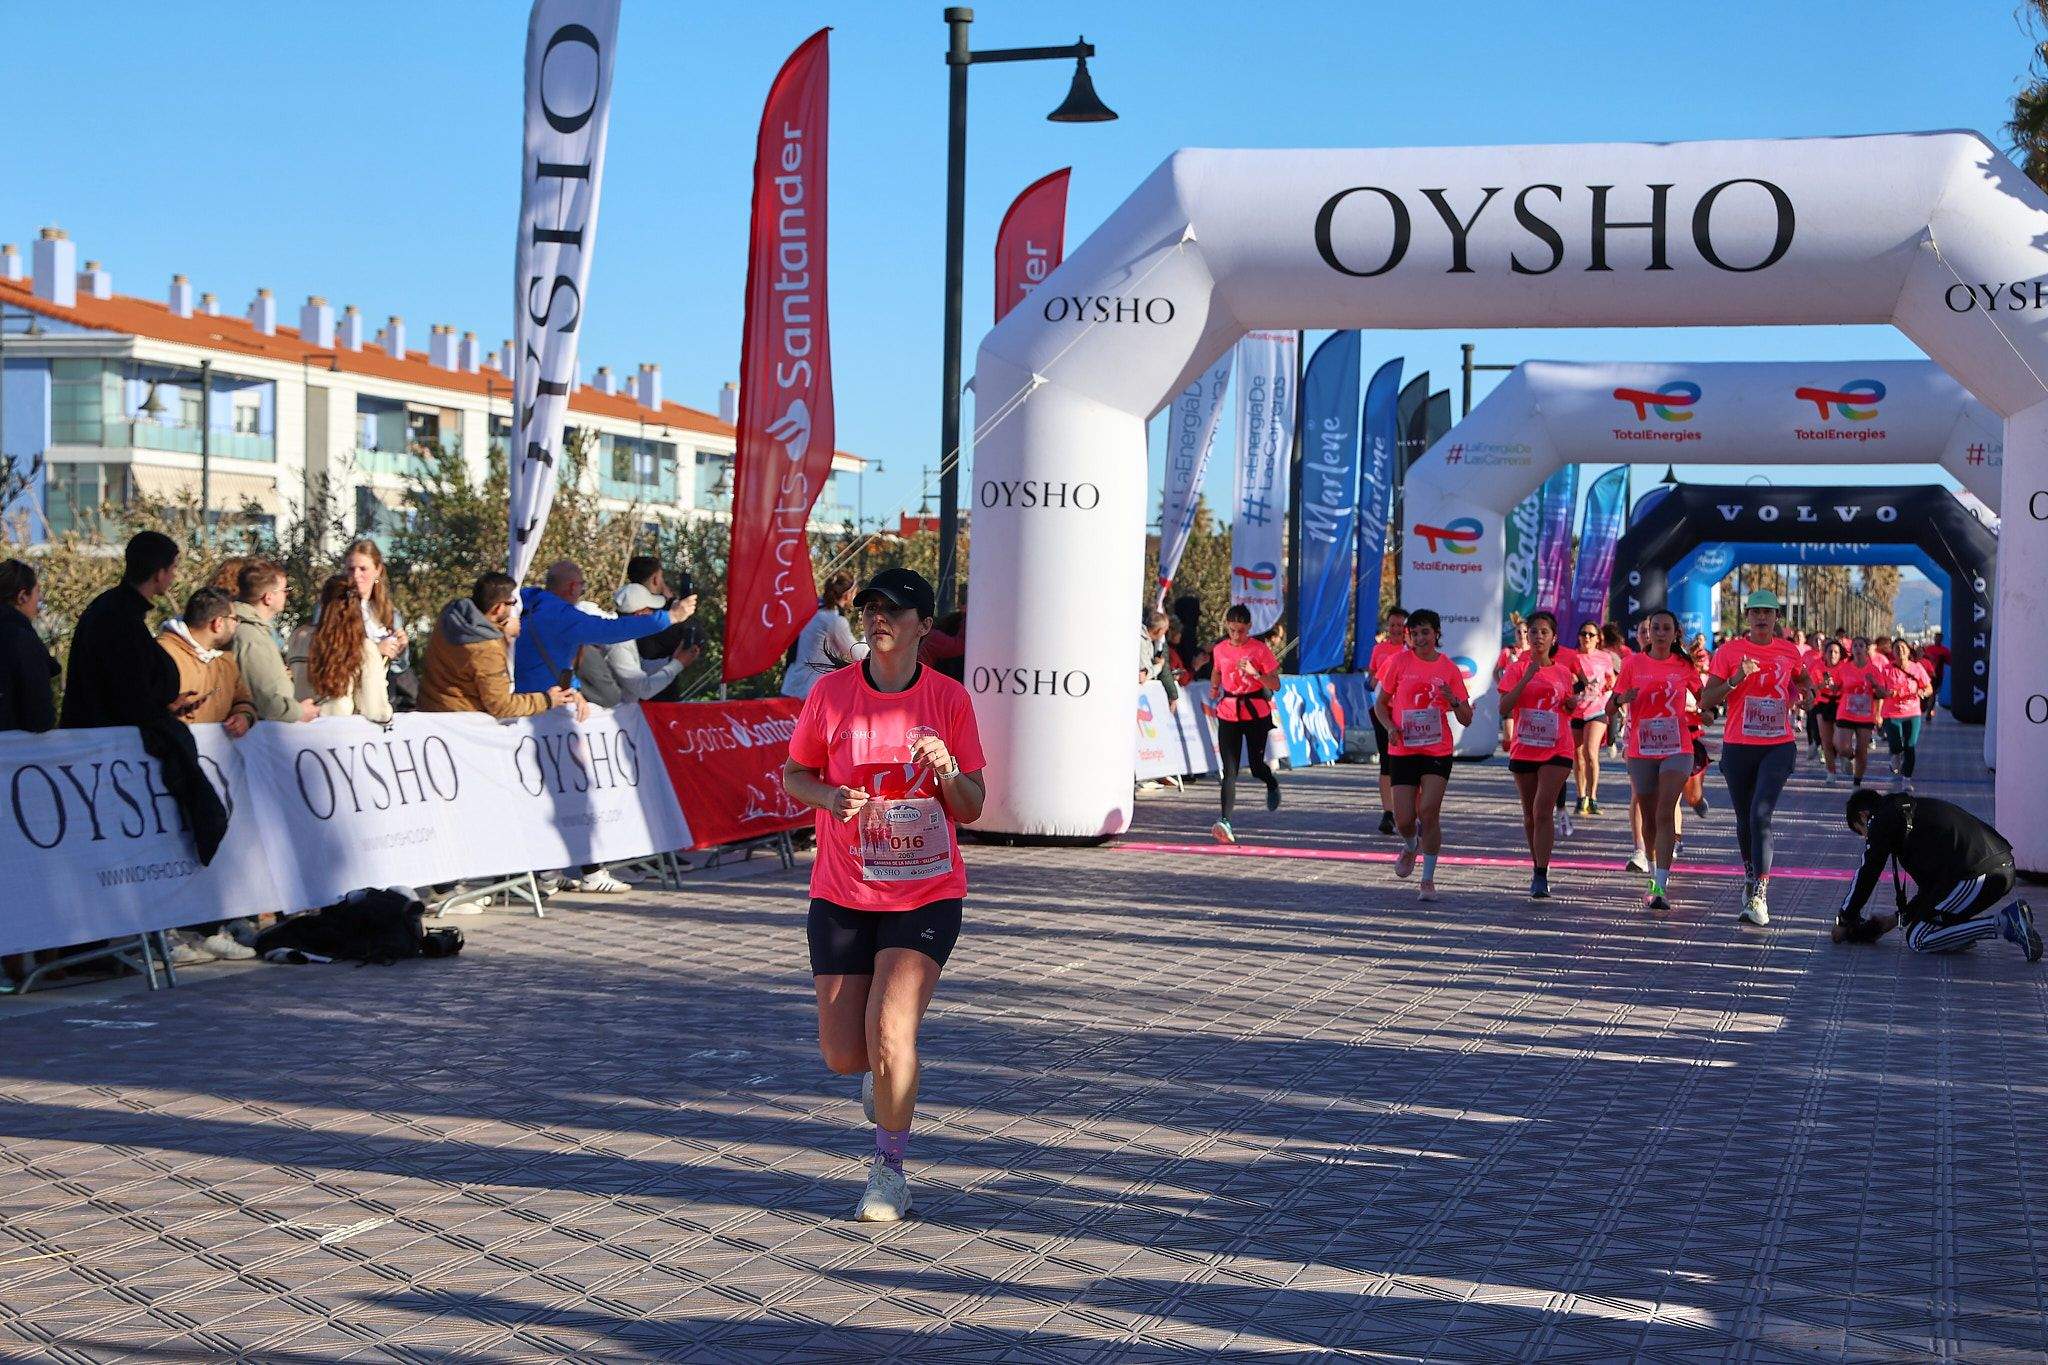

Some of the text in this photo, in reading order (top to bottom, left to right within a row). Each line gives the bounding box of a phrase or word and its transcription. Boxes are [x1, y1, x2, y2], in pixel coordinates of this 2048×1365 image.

[1315, 178, 1795, 277] OYSHO
[774, 120, 813, 388] Santander
[1044, 295, 1175, 325] OYSHO
[1612, 429, 1702, 441] TotalEnergies
[1795, 428, 1886, 441] TotalEnergies
[981, 480, 1100, 510] OYSHO
[1304, 416, 1352, 544] Marlene
[1716, 504, 1898, 522] VOLVO
[1412, 561, 1483, 574] TotalEnergies
[1973, 576, 1987, 705] VOLVO
[973, 666, 1091, 698] OYSHO
[295, 735, 459, 820] OYSHO
[514, 728, 640, 797] OYSHO
[890, 835, 925, 850] 016
[873, 868, 901, 876] OYSHO
